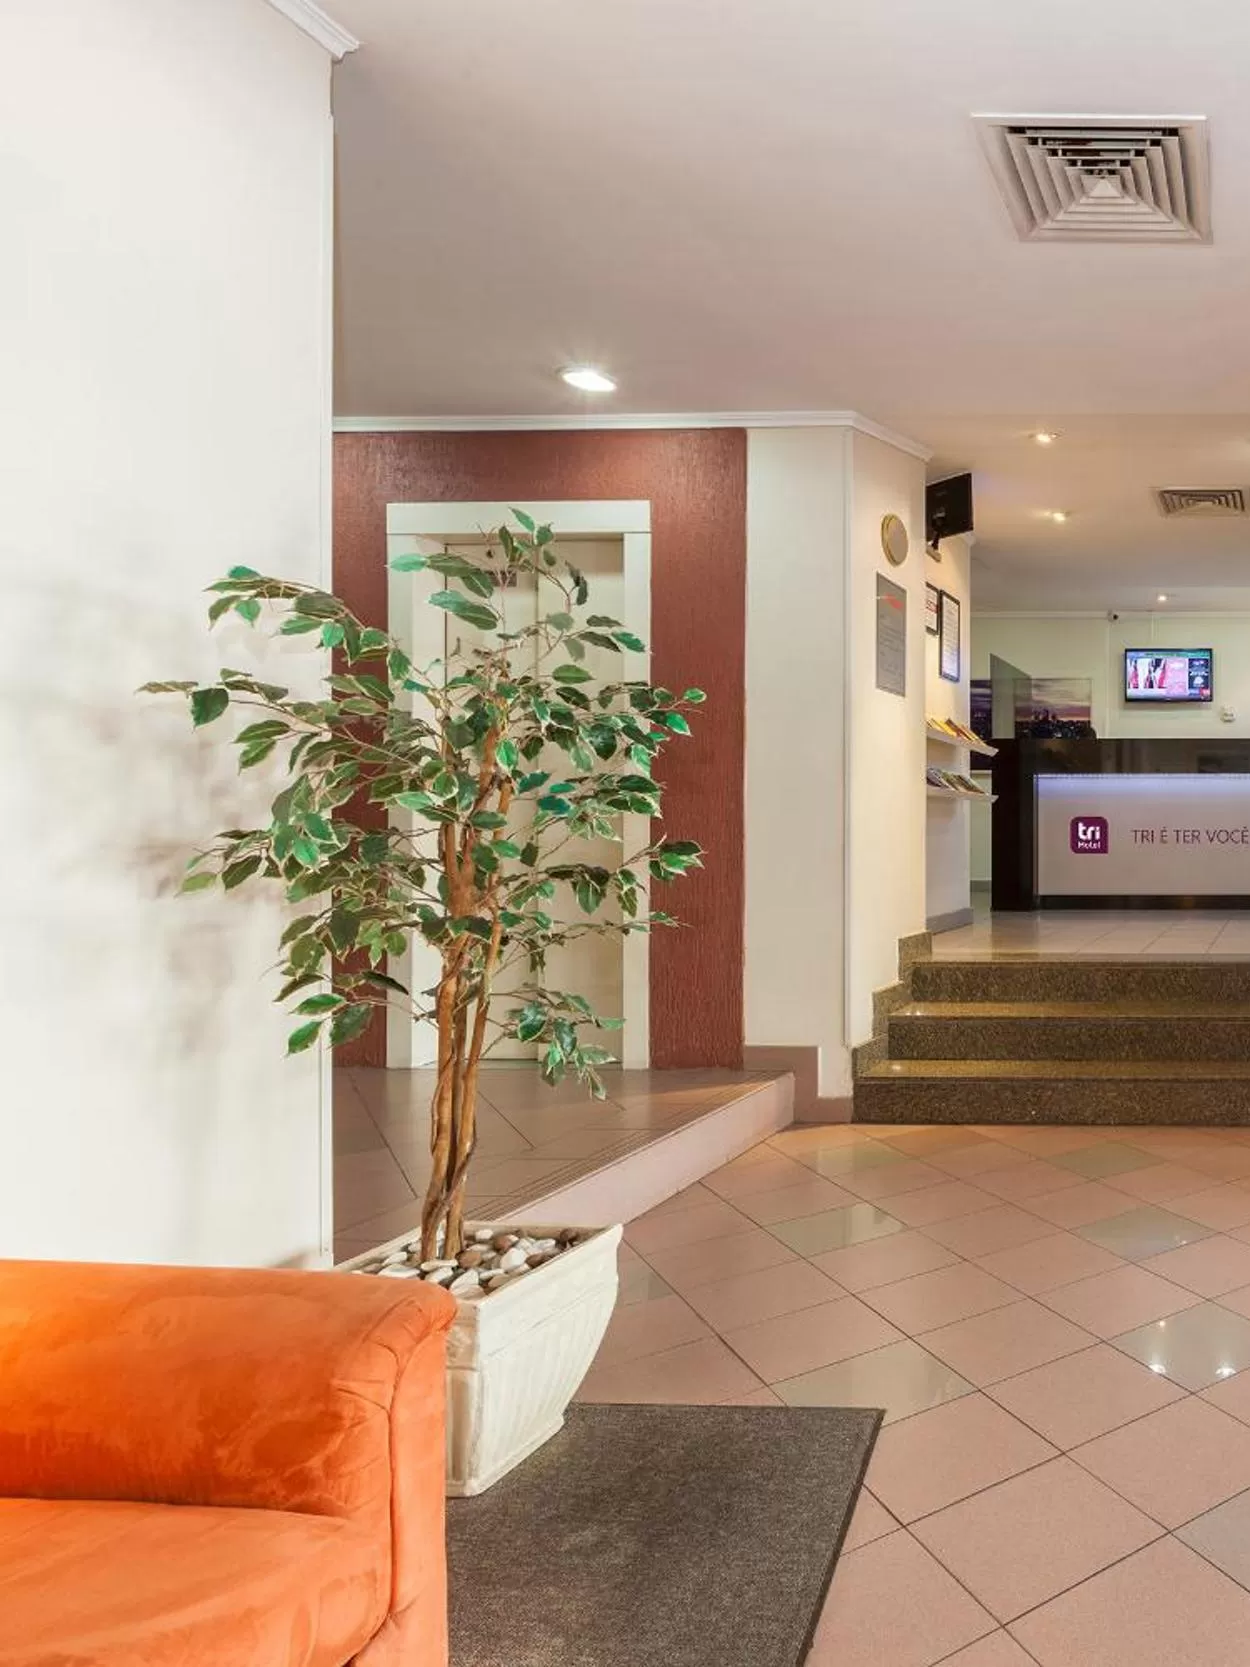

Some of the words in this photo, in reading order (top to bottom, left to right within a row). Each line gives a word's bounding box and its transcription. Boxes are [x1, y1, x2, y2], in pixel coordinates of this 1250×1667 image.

[1078, 822, 1100, 840] tri
[1131, 829, 1154, 844] TRI
[1160, 826, 1168, 844] É
[1173, 829, 1201, 844] TER
[1206, 826, 1249, 844] VOCÊ
[1078, 841, 1101, 850] Hotel
